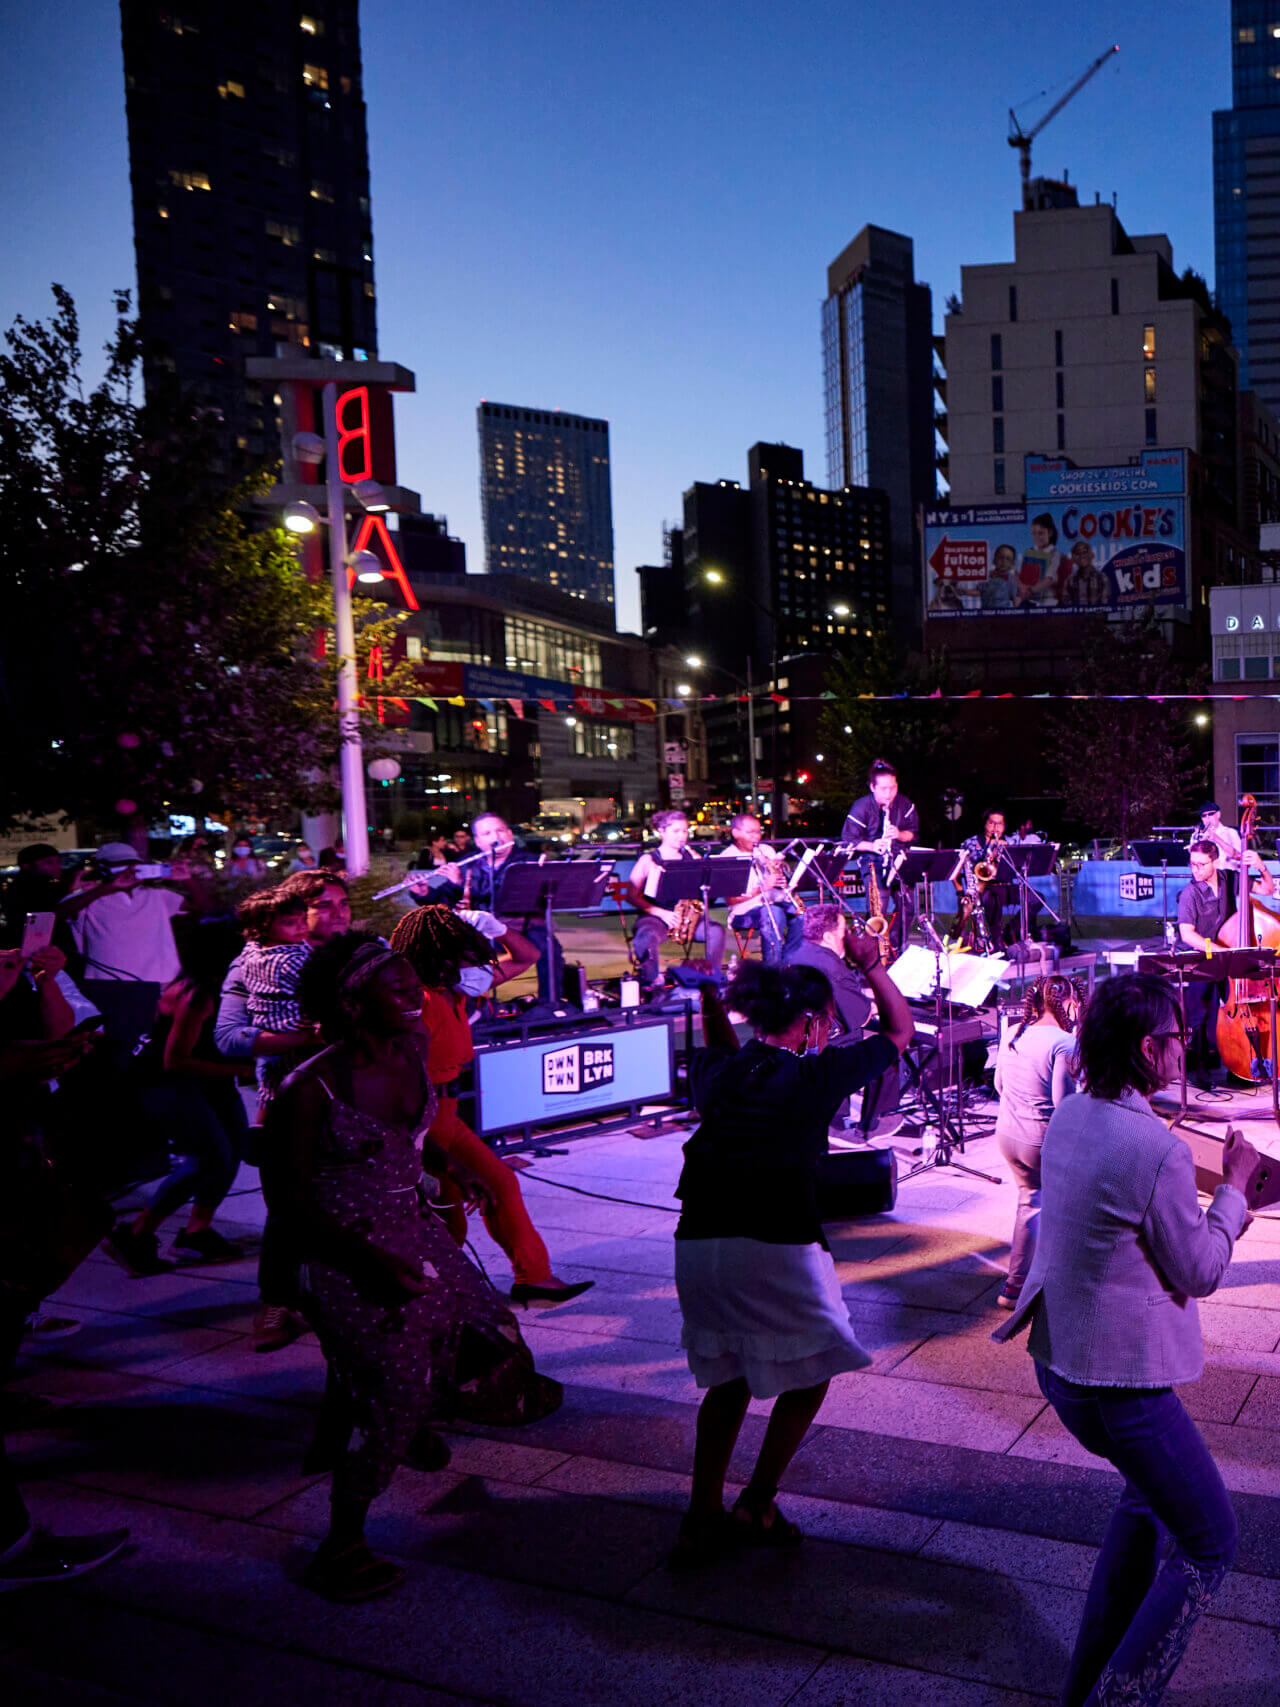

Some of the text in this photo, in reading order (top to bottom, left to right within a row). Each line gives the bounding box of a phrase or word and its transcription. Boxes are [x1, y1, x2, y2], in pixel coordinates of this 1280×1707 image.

[944, 553, 986, 565] fulton
[957, 566, 986, 577] bond
[548, 1049, 613, 1071] DWN BRK
[548, 1063, 613, 1086] TWN LYN
